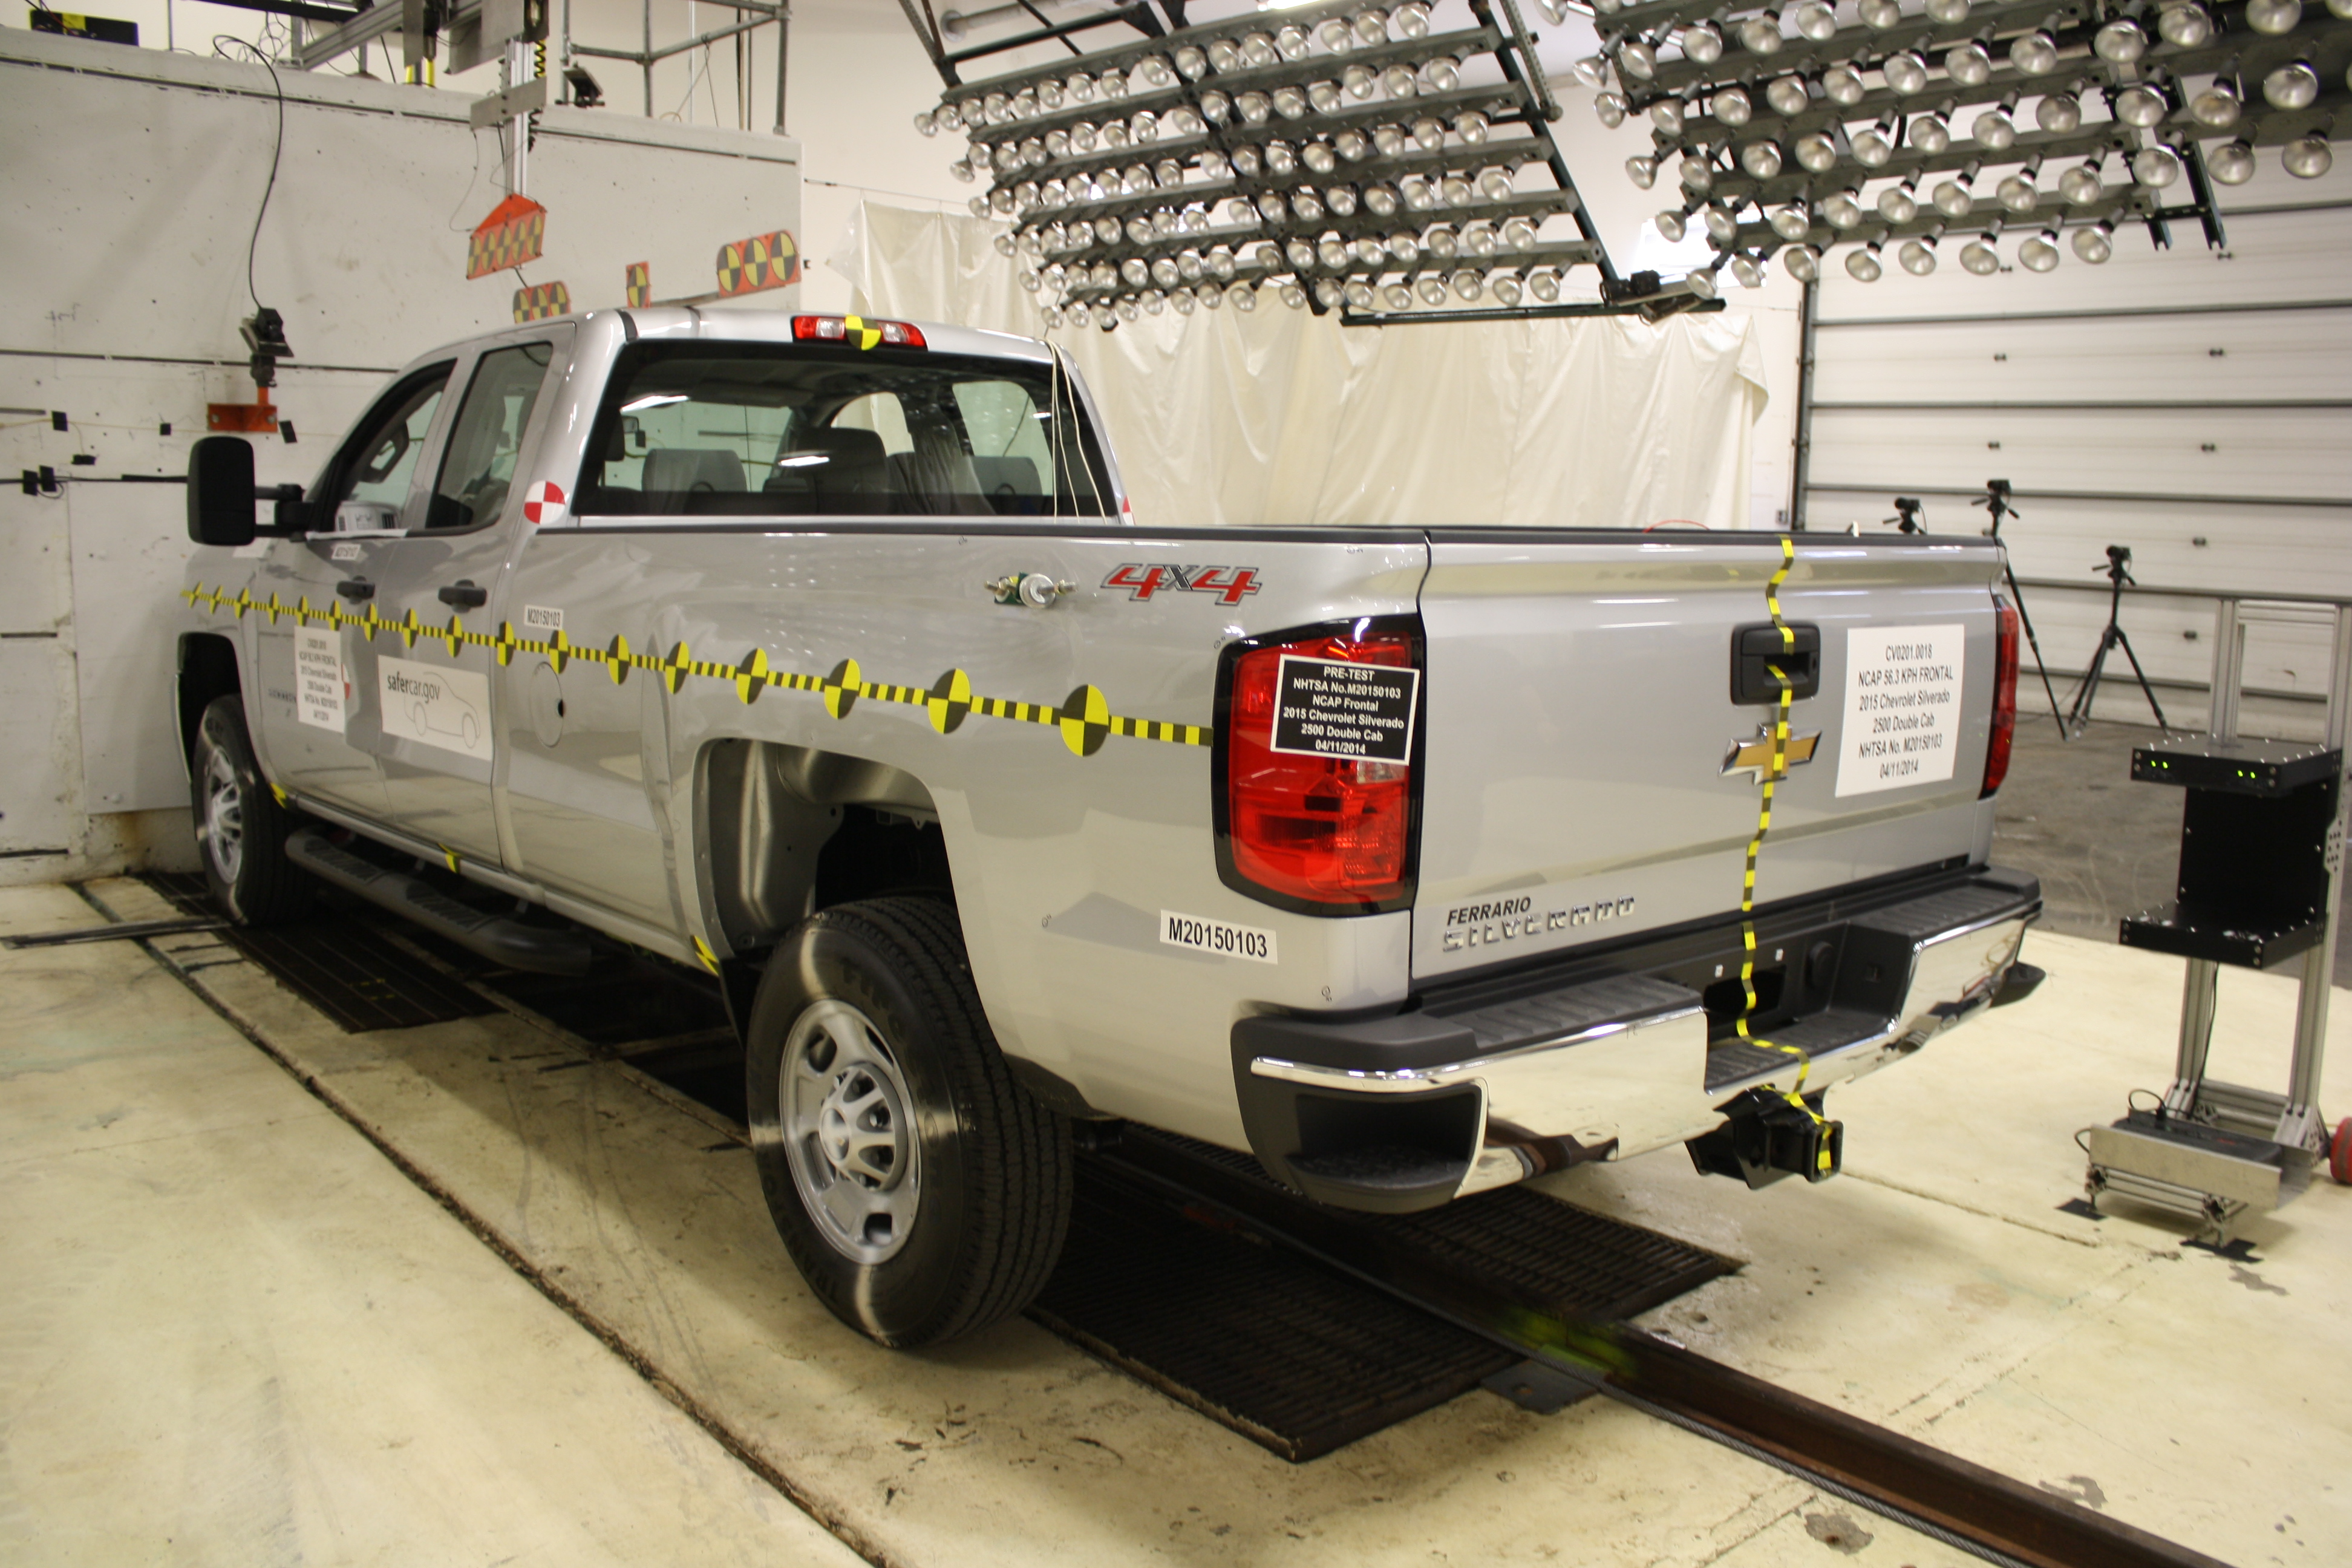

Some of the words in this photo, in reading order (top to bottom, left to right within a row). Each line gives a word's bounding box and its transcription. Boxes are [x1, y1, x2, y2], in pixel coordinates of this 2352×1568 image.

[1886, 643, 1932, 662] CV0201.0018
[1324, 666, 1375, 681] PRE-TEST
[1858, 669, 1882, 688] NCAP
[1884, 668, 1900, 685] 56.3
[1901, 667, 1918, 684] KPH
[1919, 665, 1953, 682] FRONTAL
[387, 671, 440, 704] safercar.gov
[1293, 678, 1328, 693] NHTSA
[1313, 695, 1342, 708] NCAP
[1344, 697, 1379, 712] Frontal
[1859, 694, 1878, 711] 2015
[1880, 691, 1916, 710] Chevrolet
[1918, 688, 1950, 705] Silverado
[1283, 707, 1306, 720] 2015
[1308, 708, 1356, 725] Chevrolet
[1358, 713, 1405, 729] Silverado
[1873, 717, 1891, 734] 2500
[1893, 714, 1918, 731] Double
[1920, 712, 1935, 727] Cab
[1301, 723, 1324, 736] 2500
[1326, 725, 1361, 740] Double
[1364, 729, 1383, 742] Cab
[1315, 740, 1366, 754] 04/11/2014
[1858, 740, 1886, 759] NHTSA
[1889, 740, 1901, 754] No.
[1903, 733, 1942, 753] M20150103
[1880, 759, 1918, 779] 04/11/2014
[1447, 896, 1531, 926] FERRARIO
[1443, 895, 1635, 953] SILVERADO
[1169, 916, 1267, 958] M20150103
